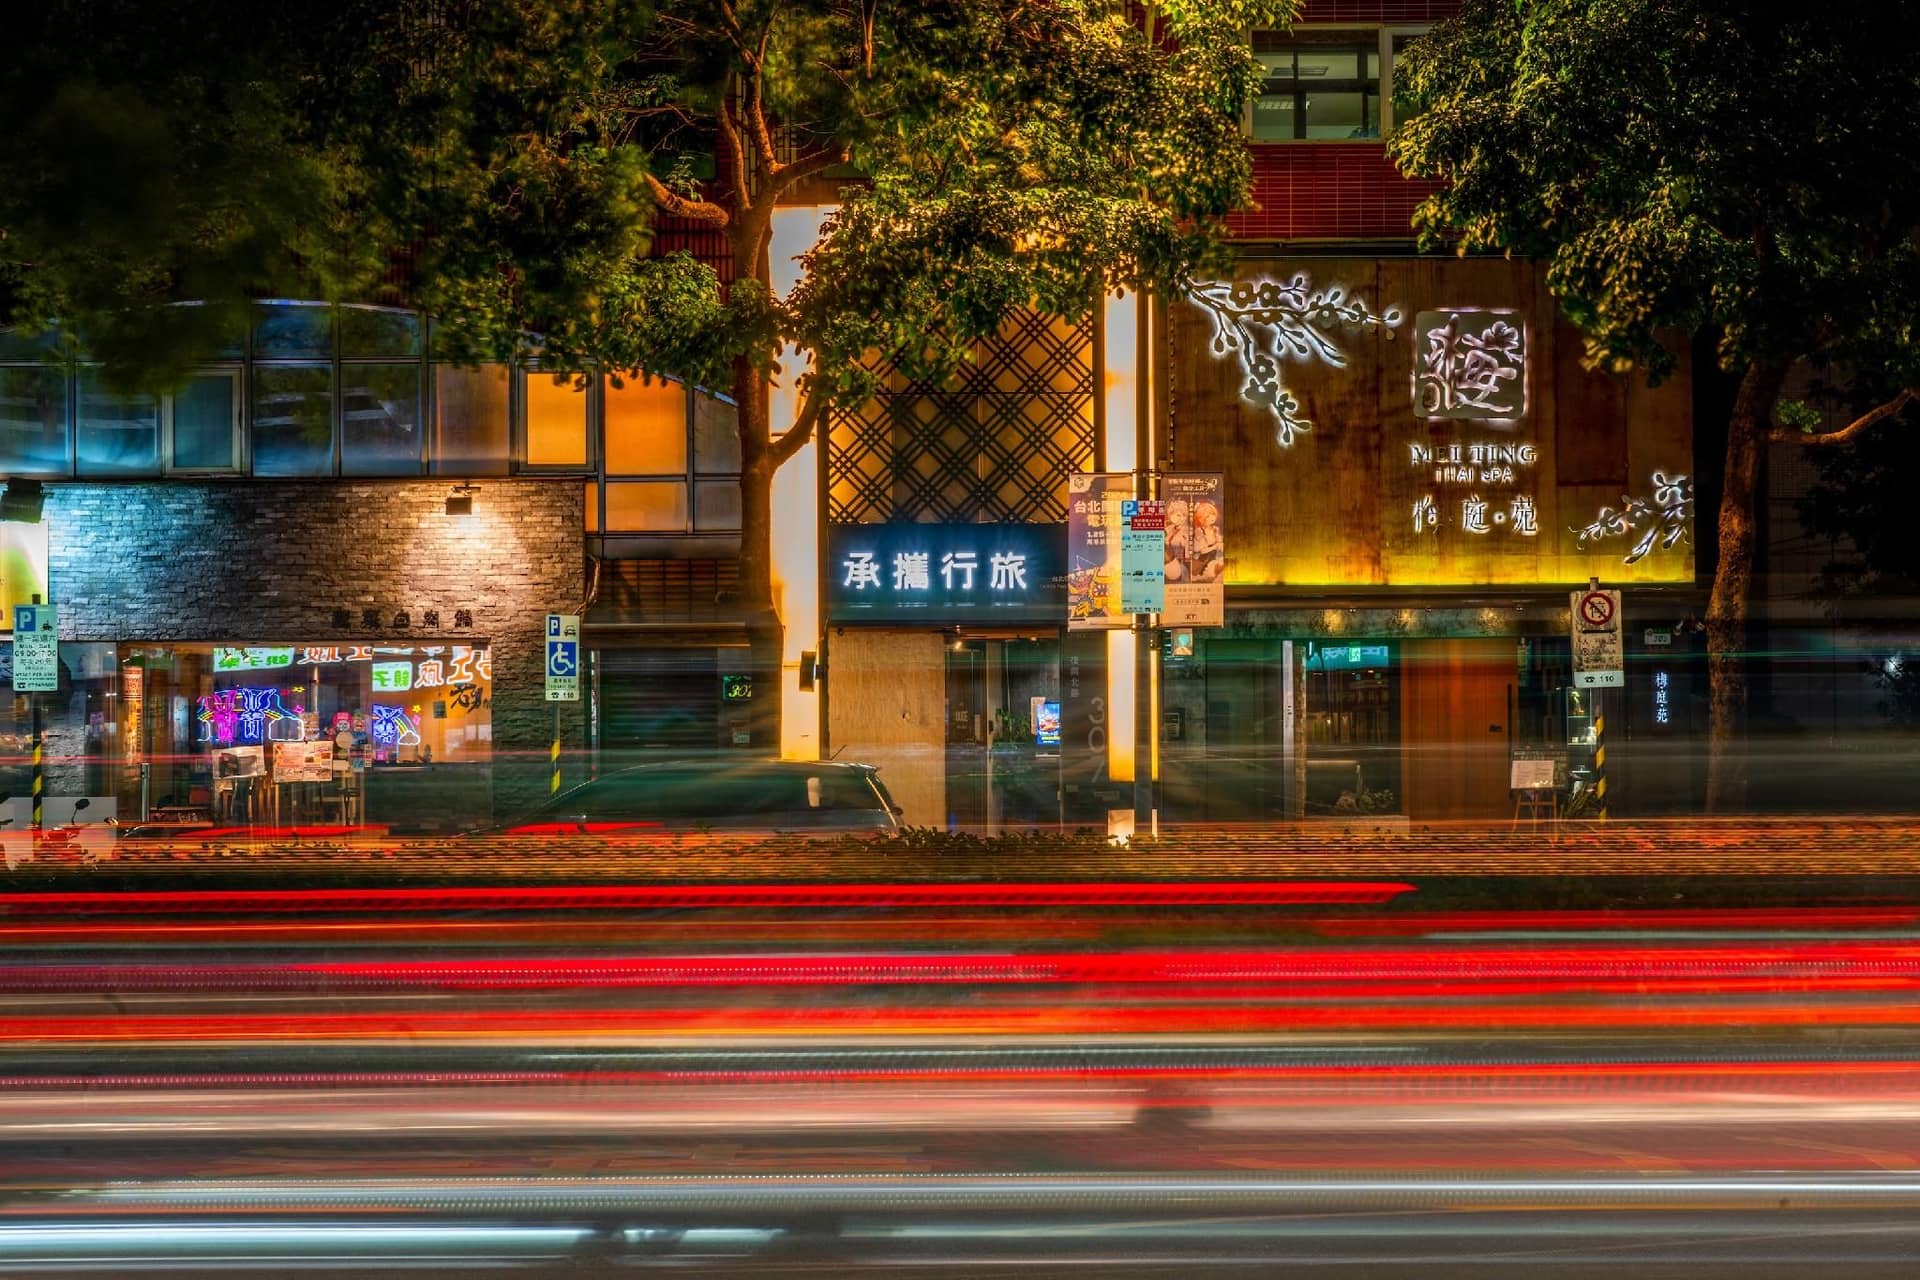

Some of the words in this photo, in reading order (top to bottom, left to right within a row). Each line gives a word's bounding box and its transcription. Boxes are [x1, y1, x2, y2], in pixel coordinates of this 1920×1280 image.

[1411, 444, 1461, 464] MEI
[1469, 443, 1537, 464] TING
[1435, 467, 1474, 482] THAI
[1481, 466, 1513, 482] SPA
[843, 552, 1027, 590] 承攜行旅
[20, 611, 32, 629] P
[551, 619, 559, 634] P
